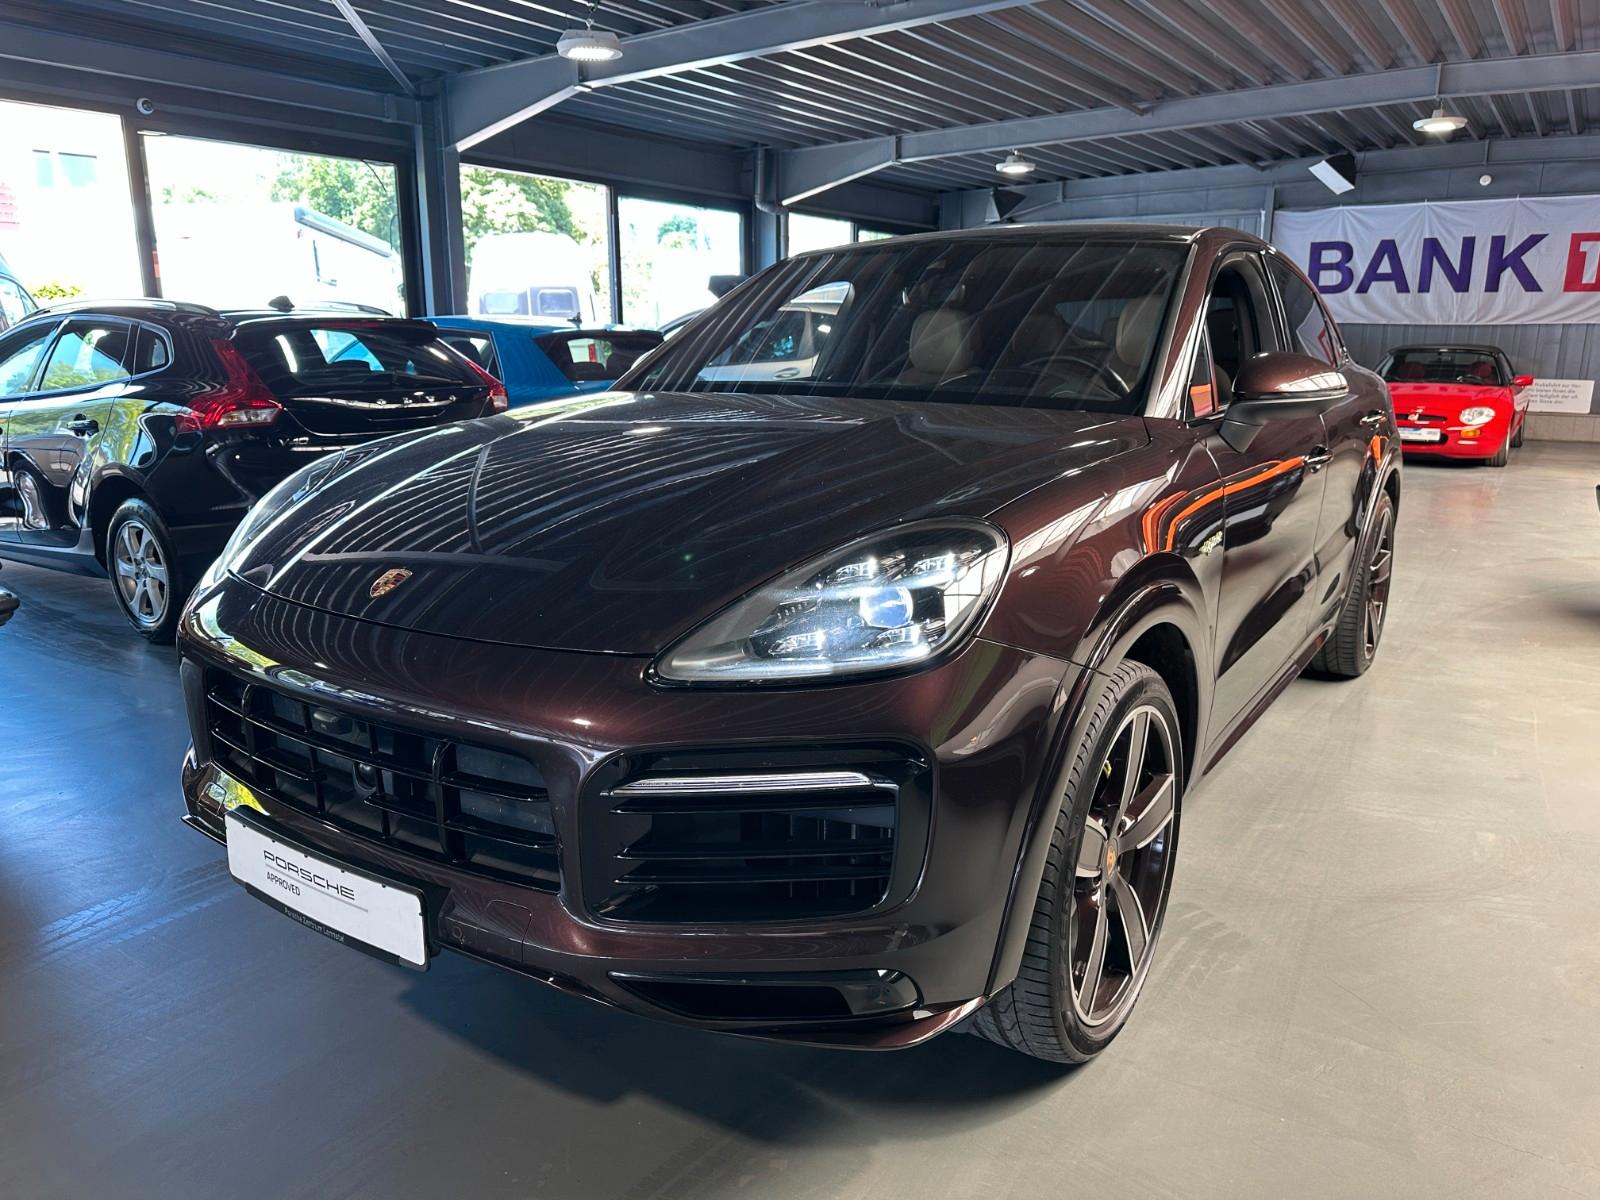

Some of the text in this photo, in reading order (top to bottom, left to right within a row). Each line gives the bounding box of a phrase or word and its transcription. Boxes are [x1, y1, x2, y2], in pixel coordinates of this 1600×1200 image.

[1308, 233, 1549, 294] BANK
[263, 850, 355, 901] PORSCHE
[266, 871, 301, 896] APPROVED
